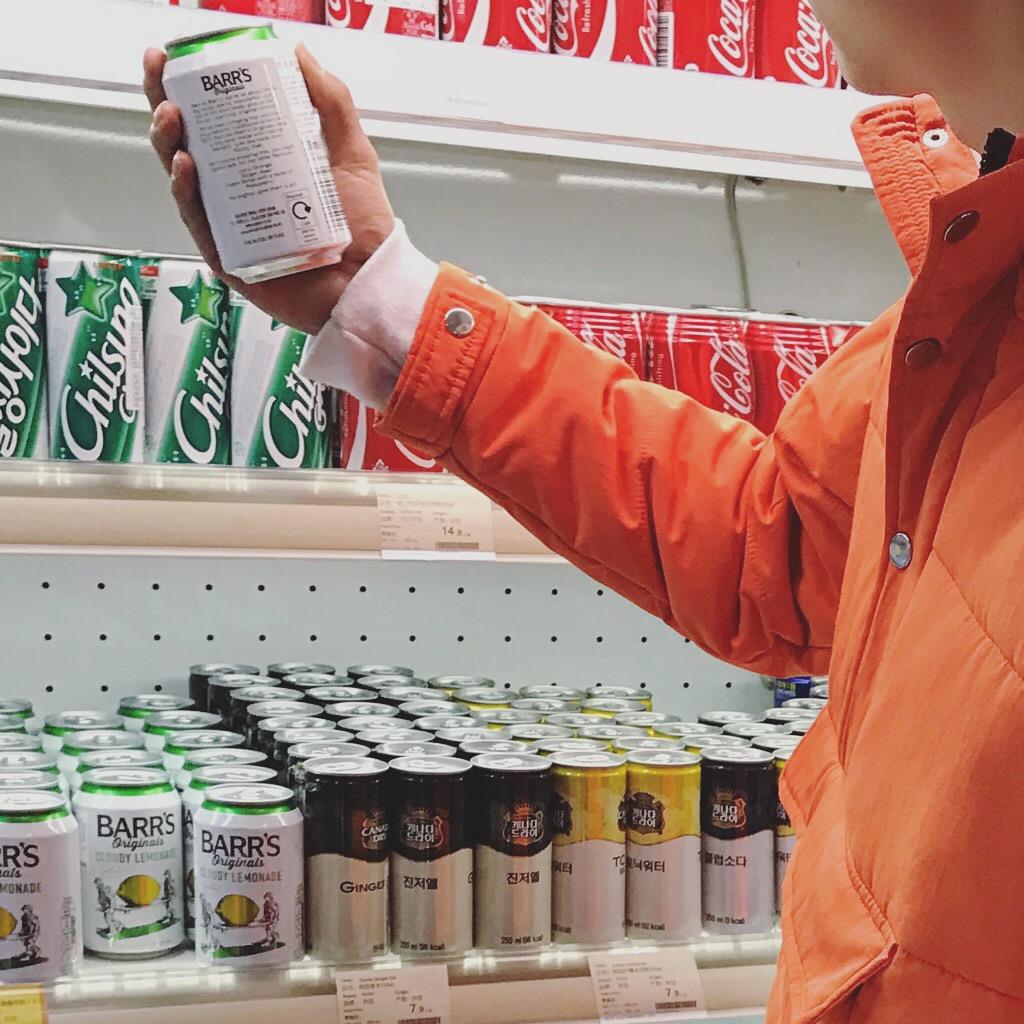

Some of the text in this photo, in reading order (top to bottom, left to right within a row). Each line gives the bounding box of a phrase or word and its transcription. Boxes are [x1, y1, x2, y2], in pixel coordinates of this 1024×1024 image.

[201, 68, 252, 92] BARR'S
[96, 812, 176, 838] BARR'S
[112, 836, 165, 851] Originals
[201, 829, 281, 858] BARR'S
[212, 853, 265, 869] Originals
[232, 870, 283, 883] LEMONADE
